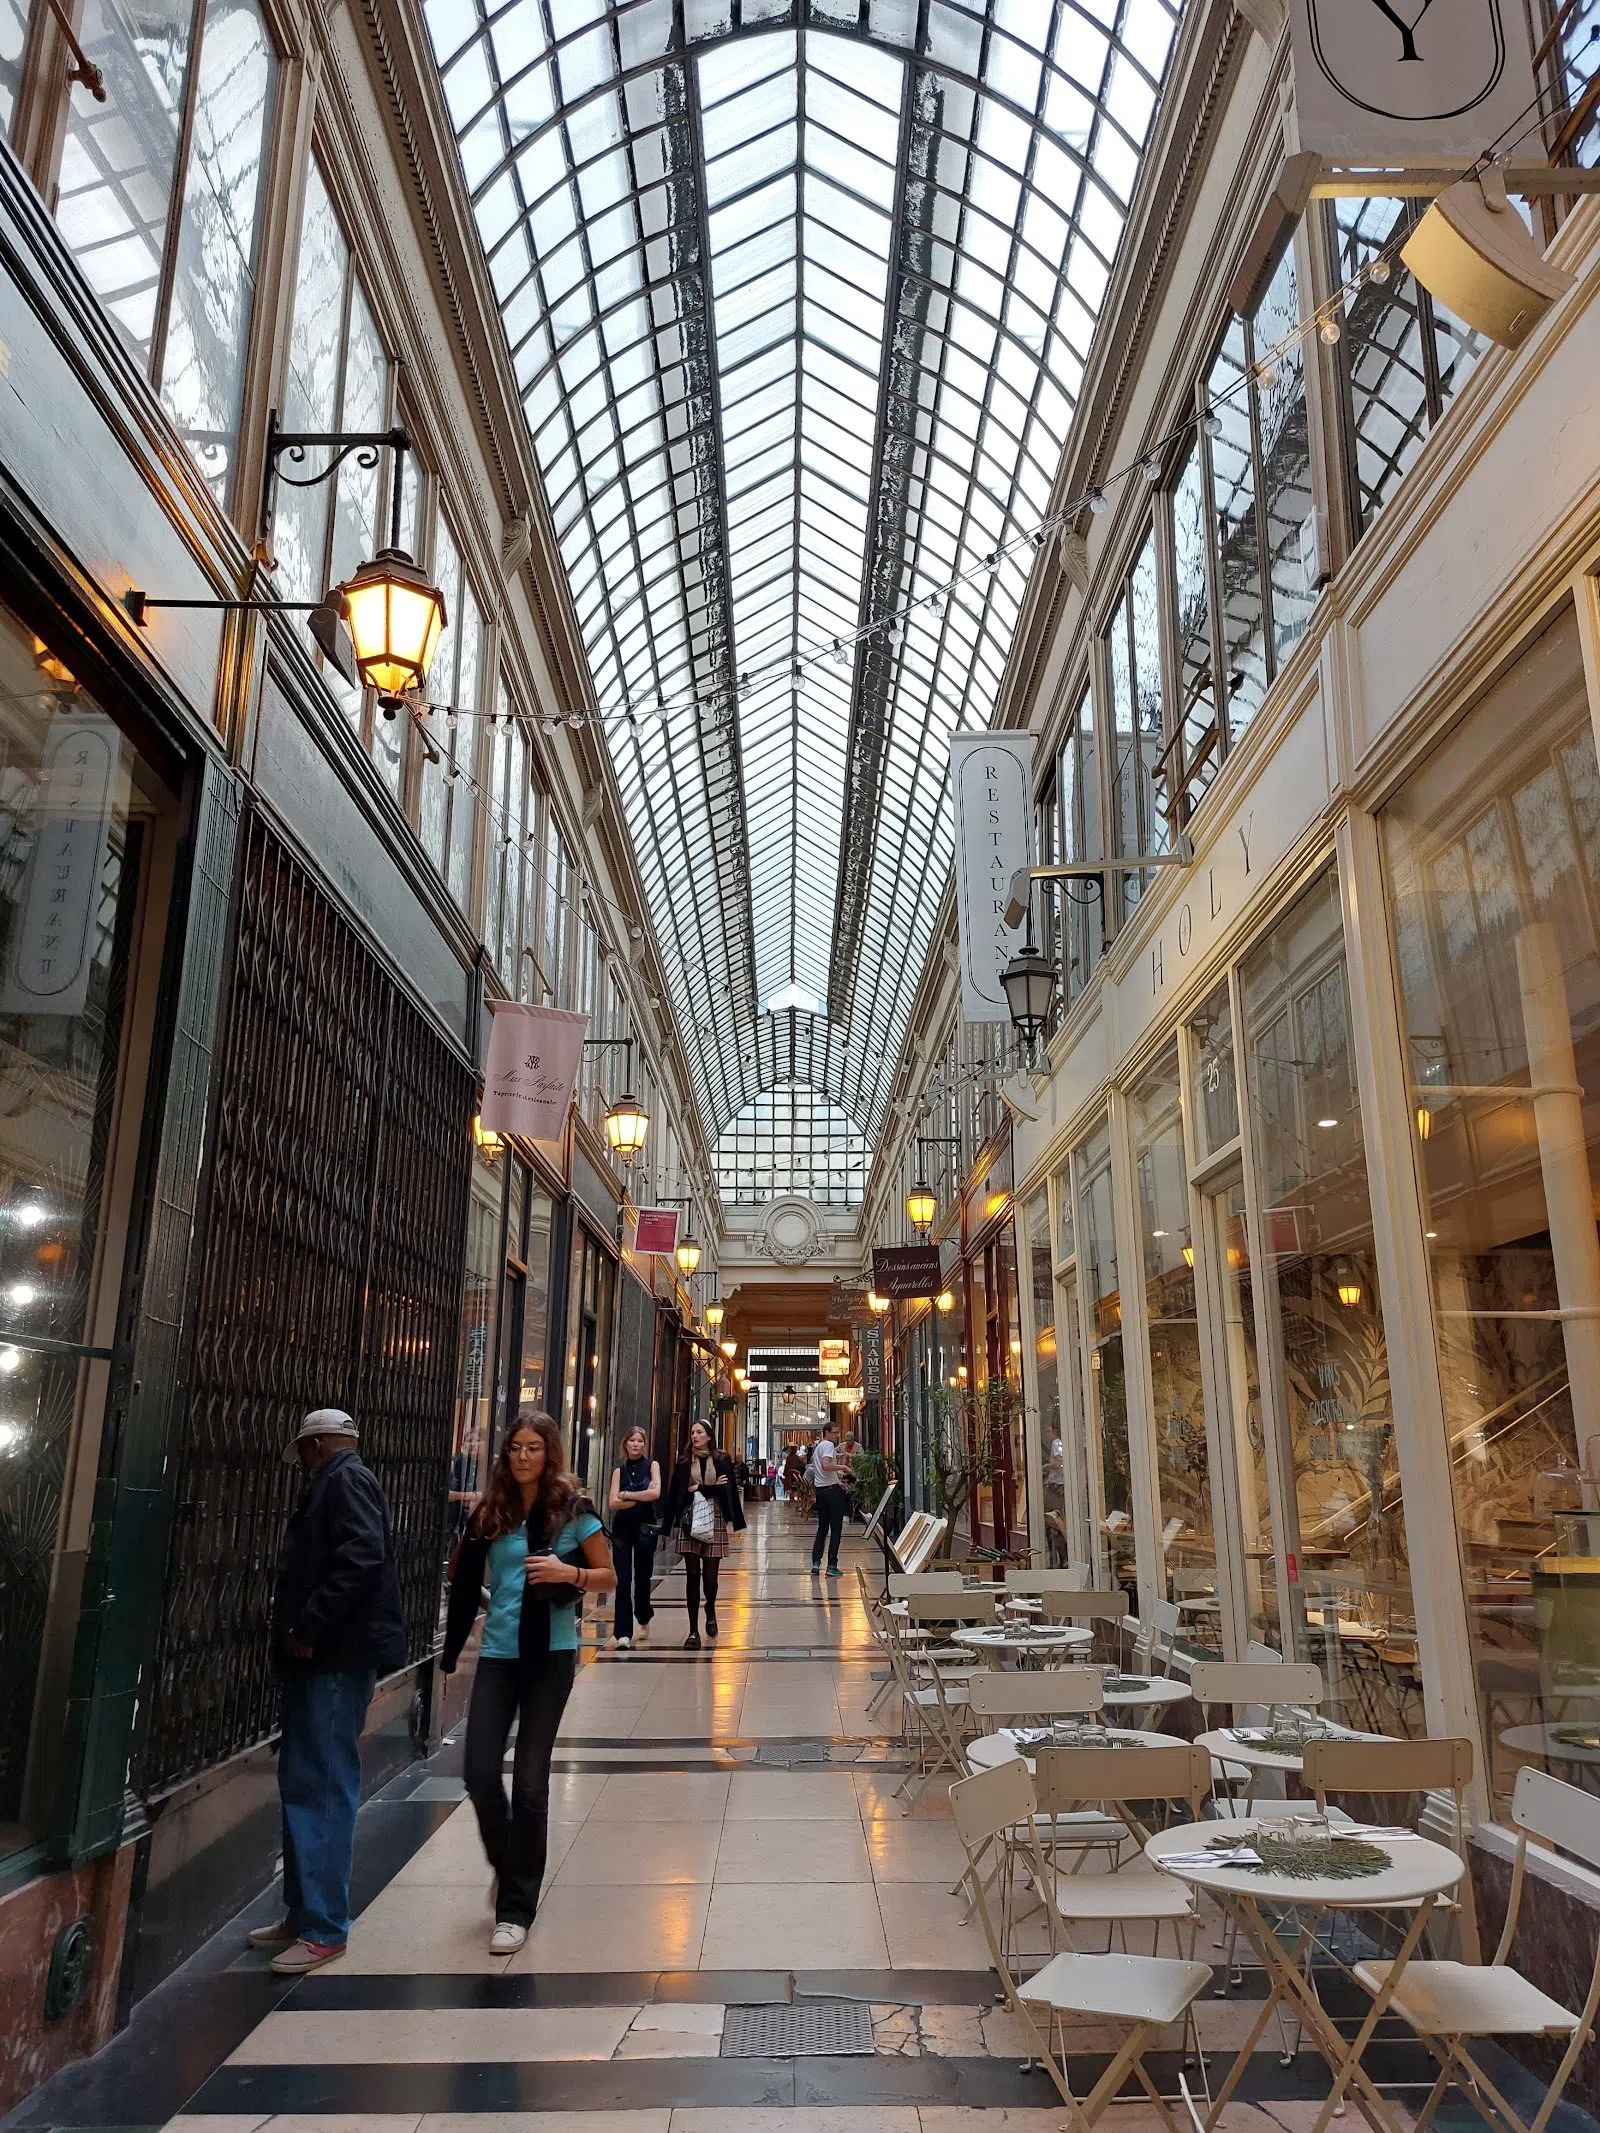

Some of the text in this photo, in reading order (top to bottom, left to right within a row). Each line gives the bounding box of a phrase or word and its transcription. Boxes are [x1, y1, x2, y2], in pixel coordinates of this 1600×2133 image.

[984, 765, 1009, 977] RESTAURAN
[1151, 810, 1254, 996] HOLY
[492, 1067, 565, 1096] Miss Parfaite
[1207, 1056, 1220, 1095] 25
[875, 1257, 938, 1273] Dessins anciens
[883, 1276, 934, 1295] Aquarelles
[866, 1325, 881, 1394] STAMPES
